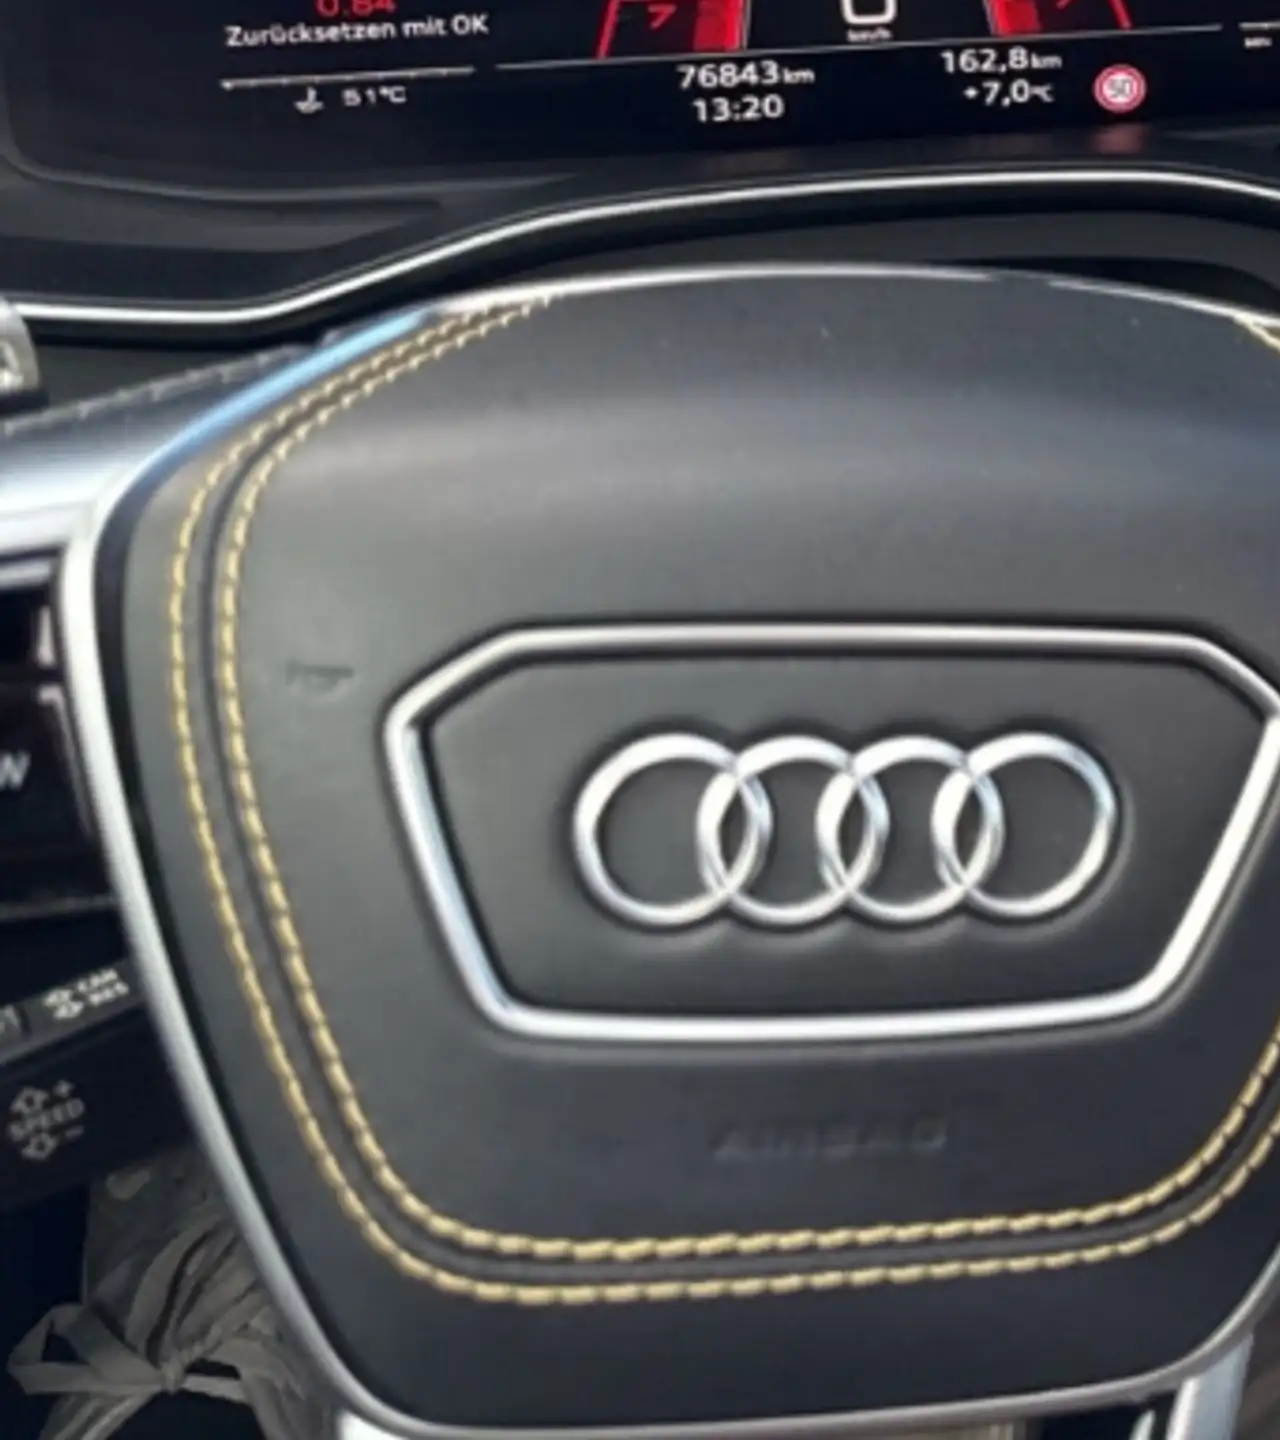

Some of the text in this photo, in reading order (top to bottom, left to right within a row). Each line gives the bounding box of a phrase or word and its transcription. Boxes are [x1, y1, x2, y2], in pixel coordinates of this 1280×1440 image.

[225, 14, 489, 47] Zurücksetzen mit OK
[647, 3, 678, 30] 7
[692, 93, 785, 122] 13:20
